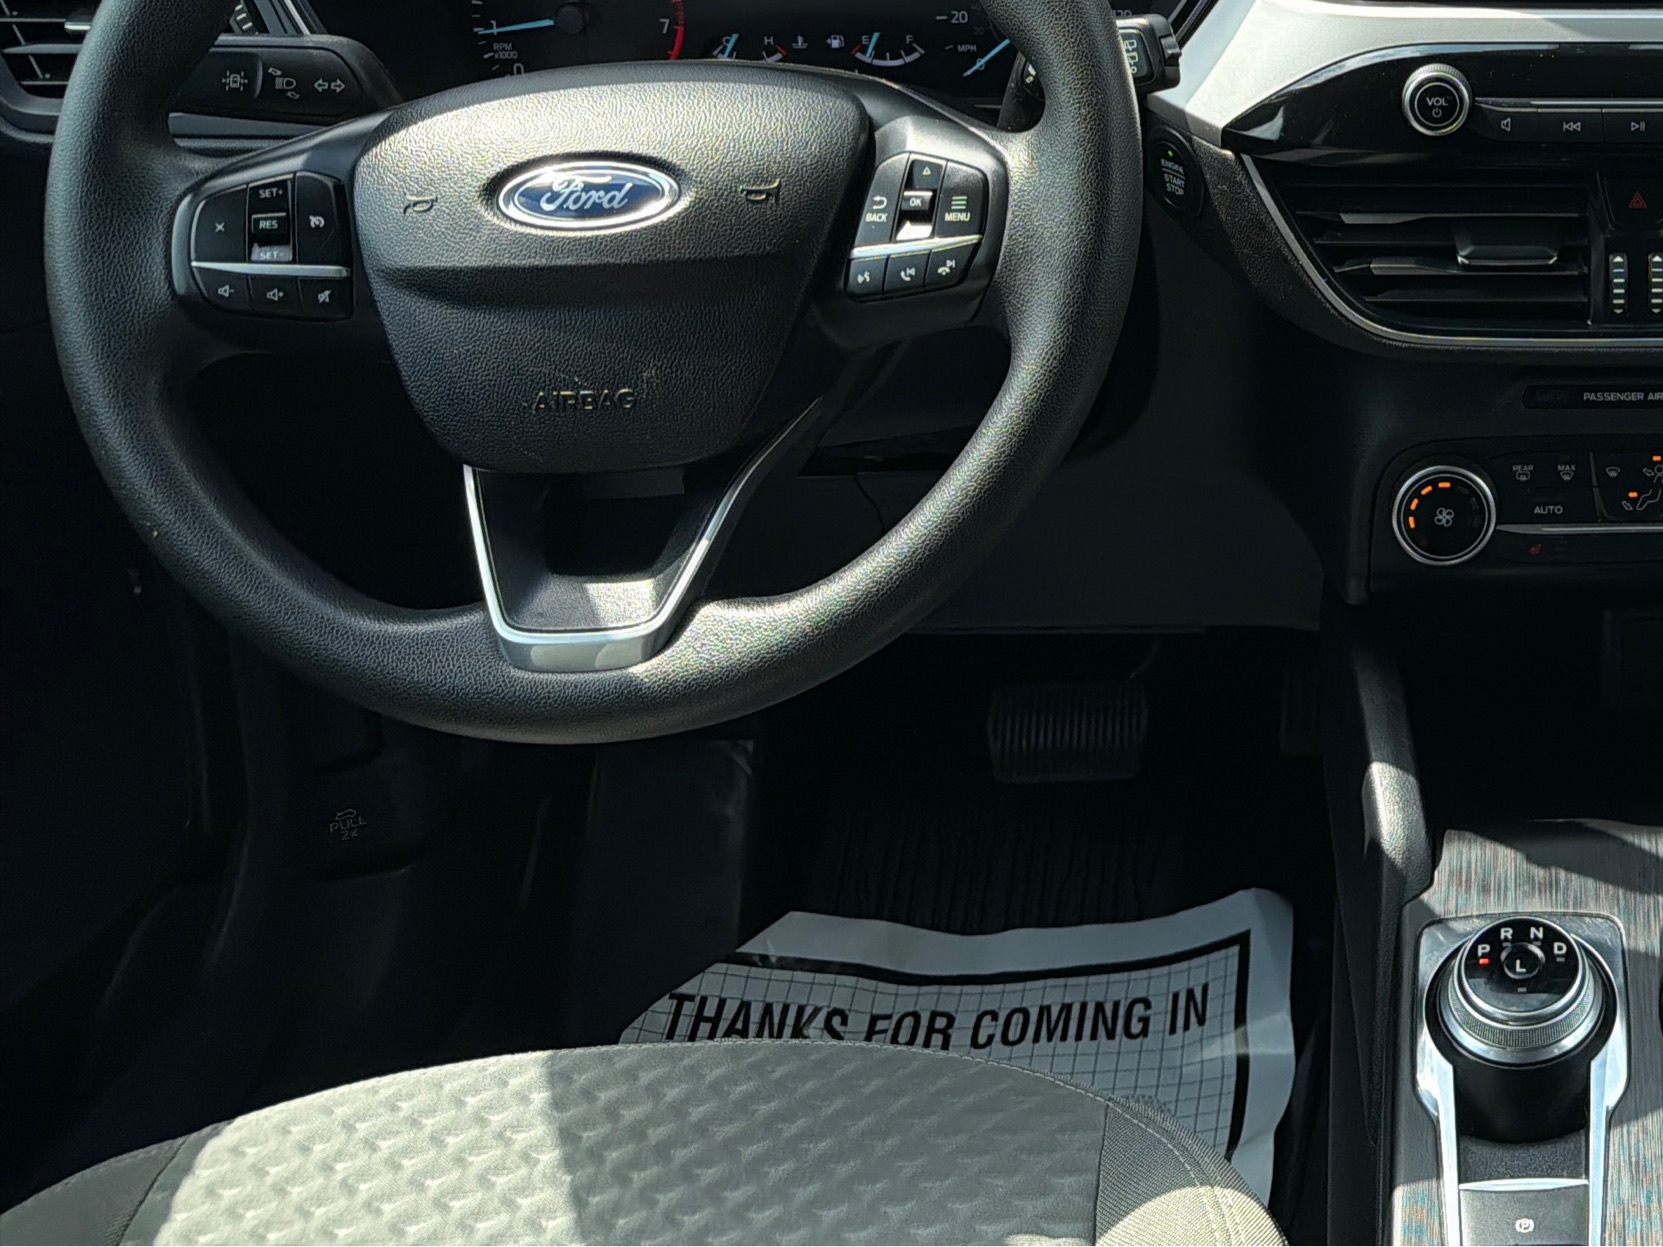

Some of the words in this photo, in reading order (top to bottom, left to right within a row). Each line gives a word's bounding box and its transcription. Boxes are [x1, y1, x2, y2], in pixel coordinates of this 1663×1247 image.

[951, 11, 969, 24] 20
[659, 19, 670, 34] 7
[764, 37, 774, 46] H
[862, 36, 869, 45] E
[905, 35, 913, 44] F
[493, 42, 512, 51] RPM
[957, 44, 977, 53] MPH
[1425, 96, 1448, 107] VOL
[1163, 173, 1185, 189] START
[539, 172, 633, 212] Ford
[1166, 182, 1185, 195] STOP
[909, 197, 922, 207] OK
[865, 213, 888, 223] BACK
[944, 212, 971, 222] MENU
[259, 219, 279, 230] RES
[532, 389, 634, 413] AIRBAG
[1583, 391, 1645, 401] PASSENGER
[1512, 464, 1534, 472] REAR
[1534, 505, 1564, 514] AUTO
[329, 815, 367, 833] PULL
[1477, 944, 1491, 958] P
[1500, 927, 1514, 941] R
[1529, 926, 1544, 941] N
[1554, 942, 1567, 956] D
[1515, 958, 1527, 972] L
[663, 991, 850, 1042] THANKS
[863, 1009, 956, 1051] FOR
[968, 996, 1153, 1052] COMING
[1167, 982, 1211, 1037] IN
